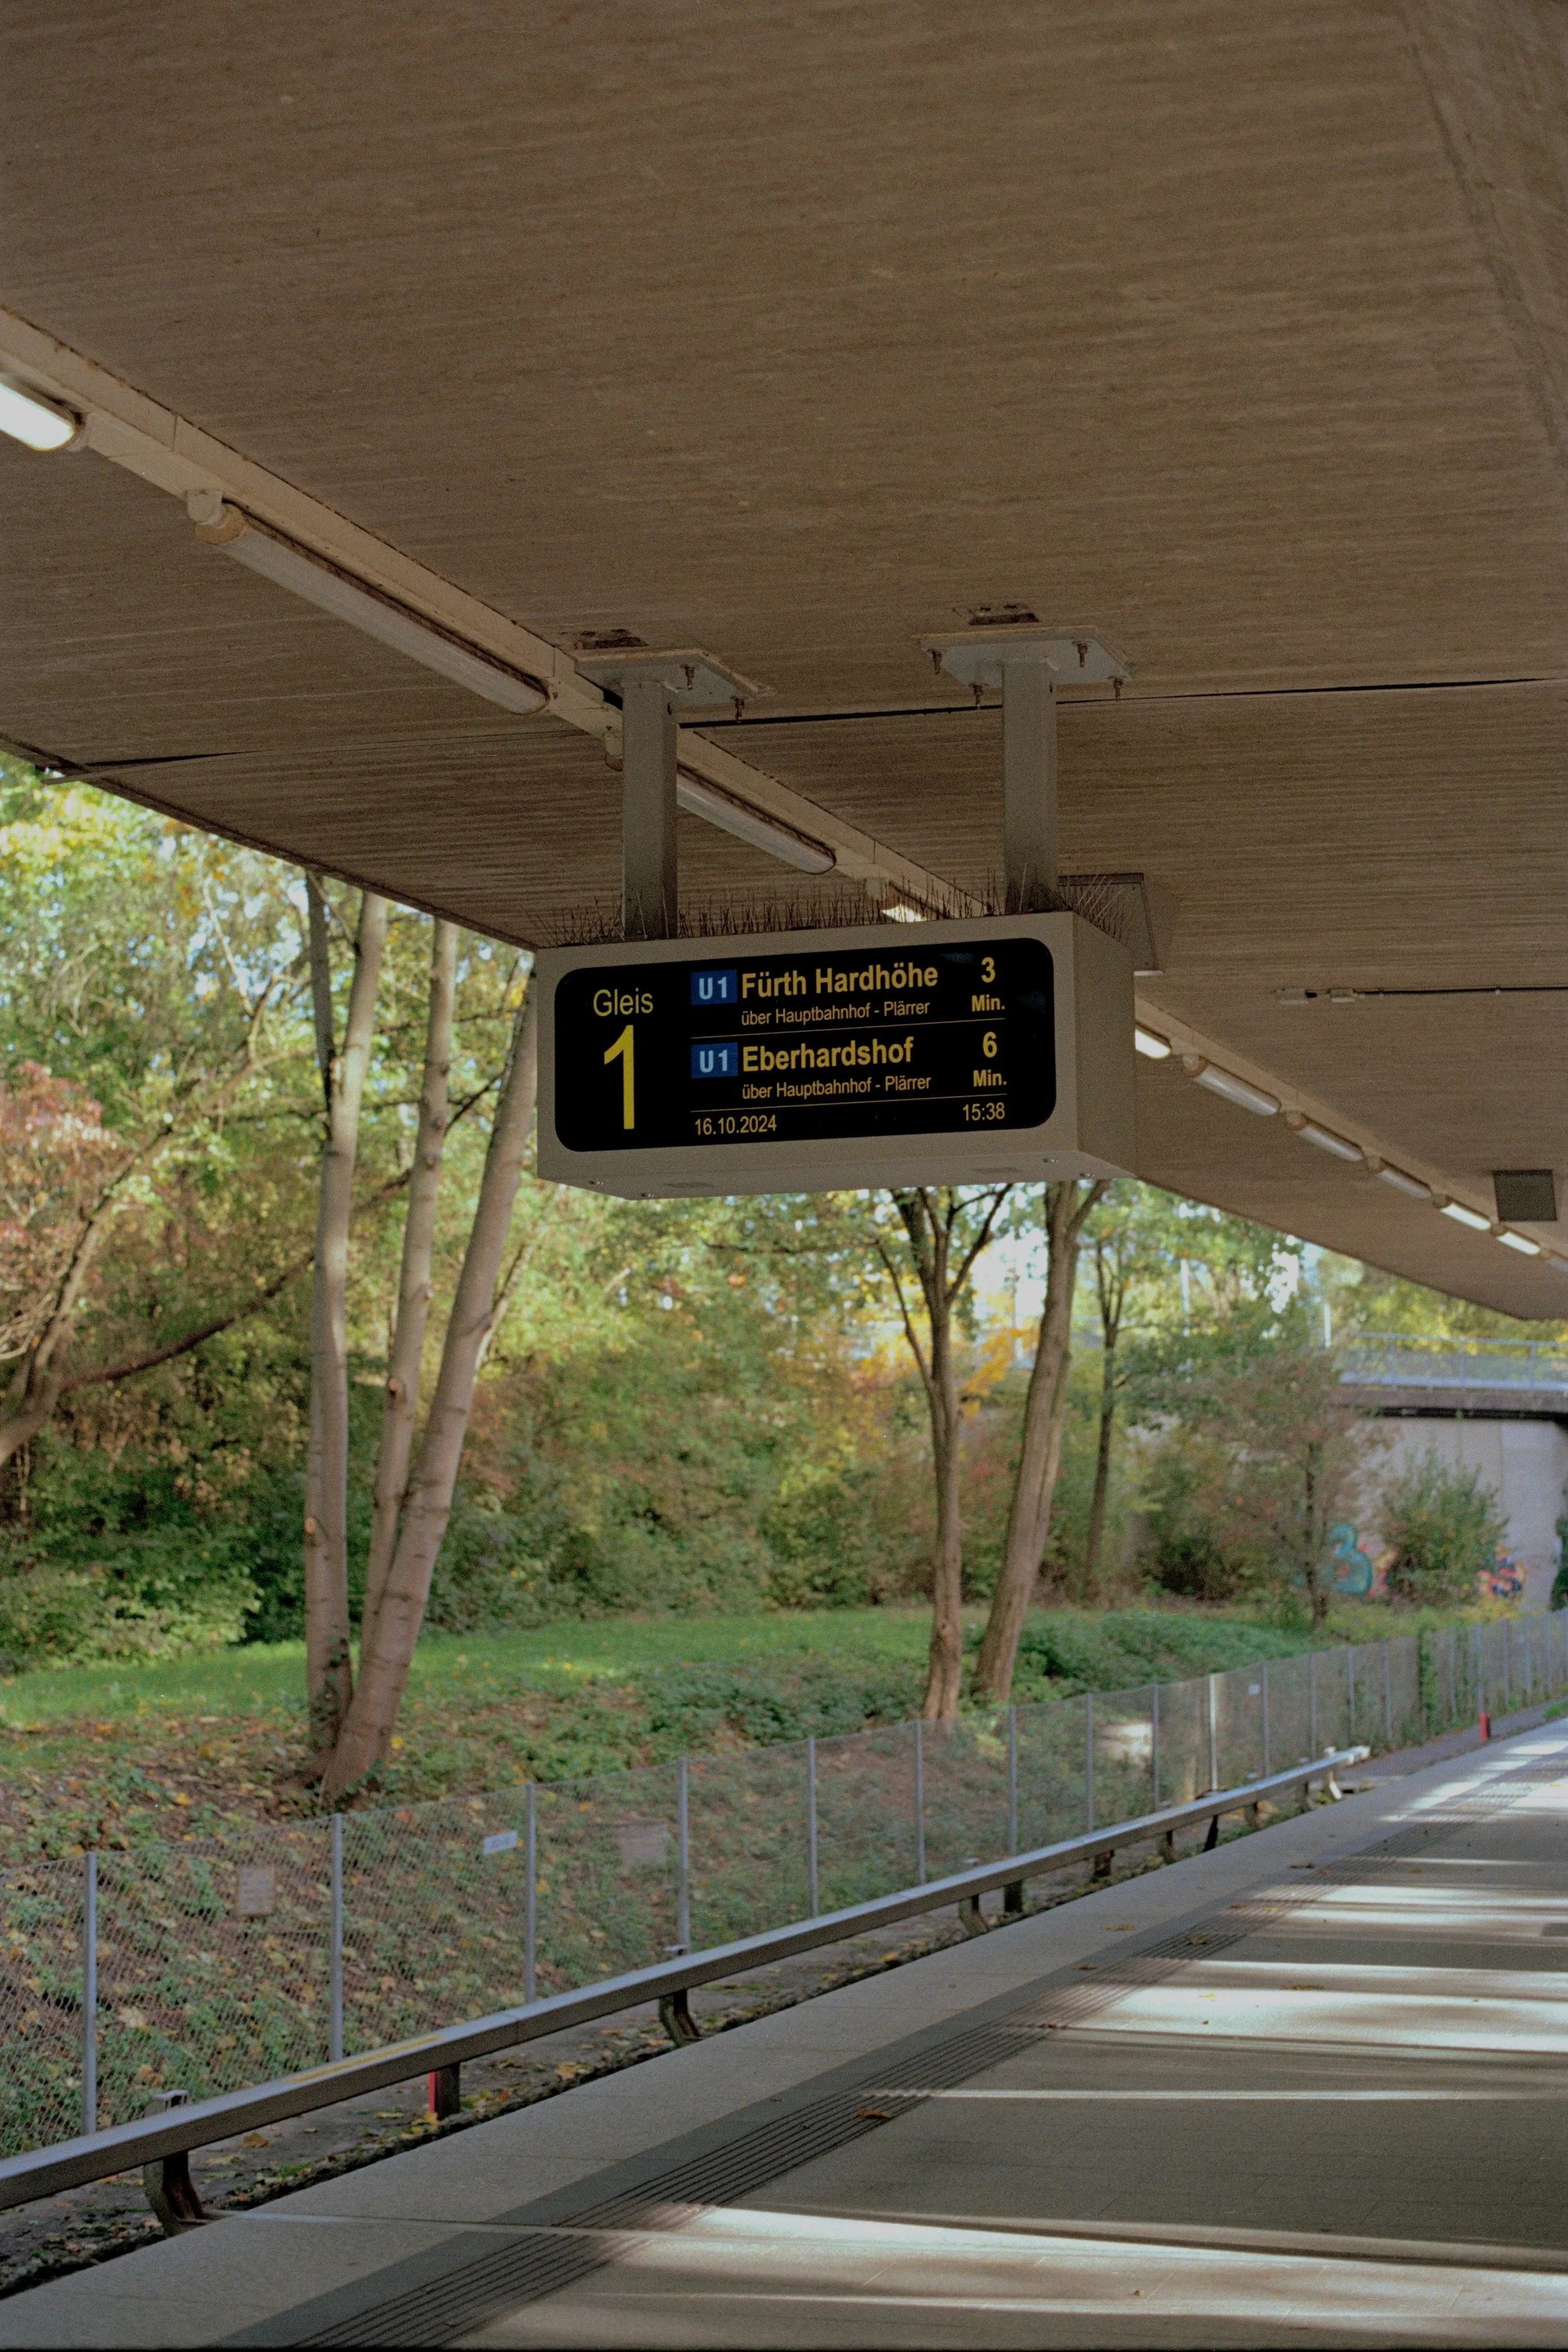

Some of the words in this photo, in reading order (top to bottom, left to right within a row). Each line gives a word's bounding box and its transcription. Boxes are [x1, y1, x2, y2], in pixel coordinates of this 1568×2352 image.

[699, 977, 726, 1000] U1
[742, 970, 807, 999] Fürth
[815, 961, 938, 994] Hardhöhe
[981, 956, 996, 983] 3
[593, 987, 654, 1017] Gleis
[741, 1010, 772, 1026] über
[775, 1002, 871, 1025] Hauptbahnhof
[884, 1000, 930, 1017] Plärrer
[971, 993, 1005, 1012] Min.
[700, 1050, 728, 1073] U1
[743, 1036, 914, 1072] Eberhardshof
[982, 1031, 998, 1058] 6
[603, 1024, 635, 1130] 1
[742, 1084, 773, 1099] über
[776, 1076, 872, 1099] Hauptbahnhof
[885, 1075, 932, 1091] Plärrer
[973, 1069, 1007, 1087] Min.
[962, 1102, 1005, 1121] 15:38
[695, 1114, 777, 1136] 16.10.2024
